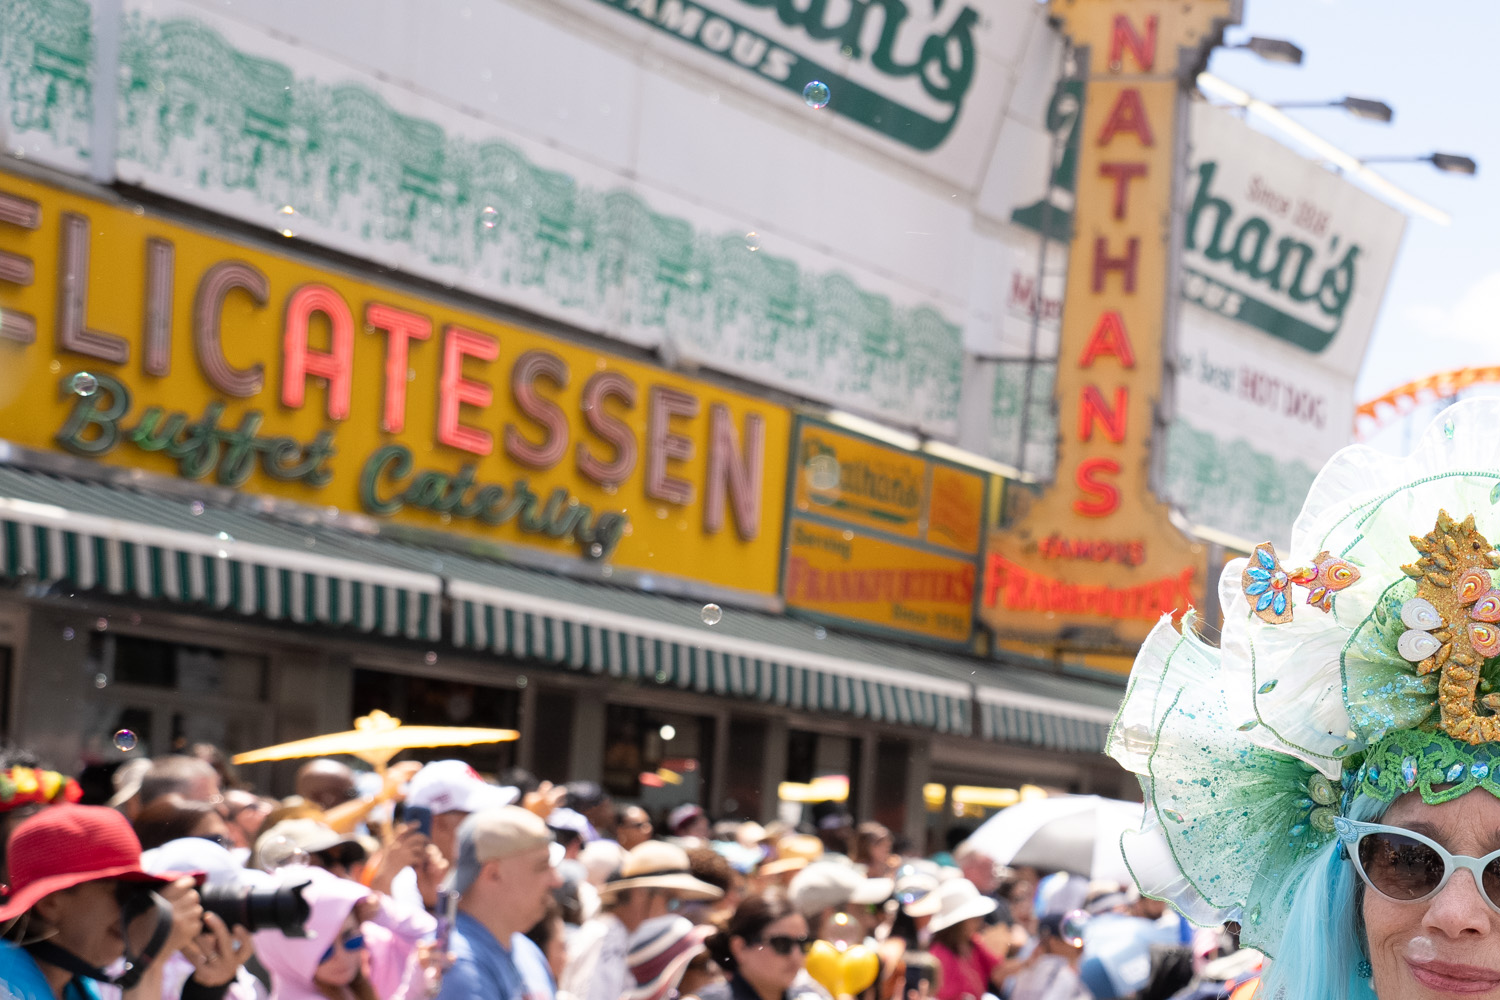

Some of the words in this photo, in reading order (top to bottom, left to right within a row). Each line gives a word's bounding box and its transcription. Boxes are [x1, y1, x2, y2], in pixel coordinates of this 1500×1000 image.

[1073, 13, 1160, 521] NATHANS
[55, 371, 336, 489] Buffet
[359, 444, 628, 561] Catering
